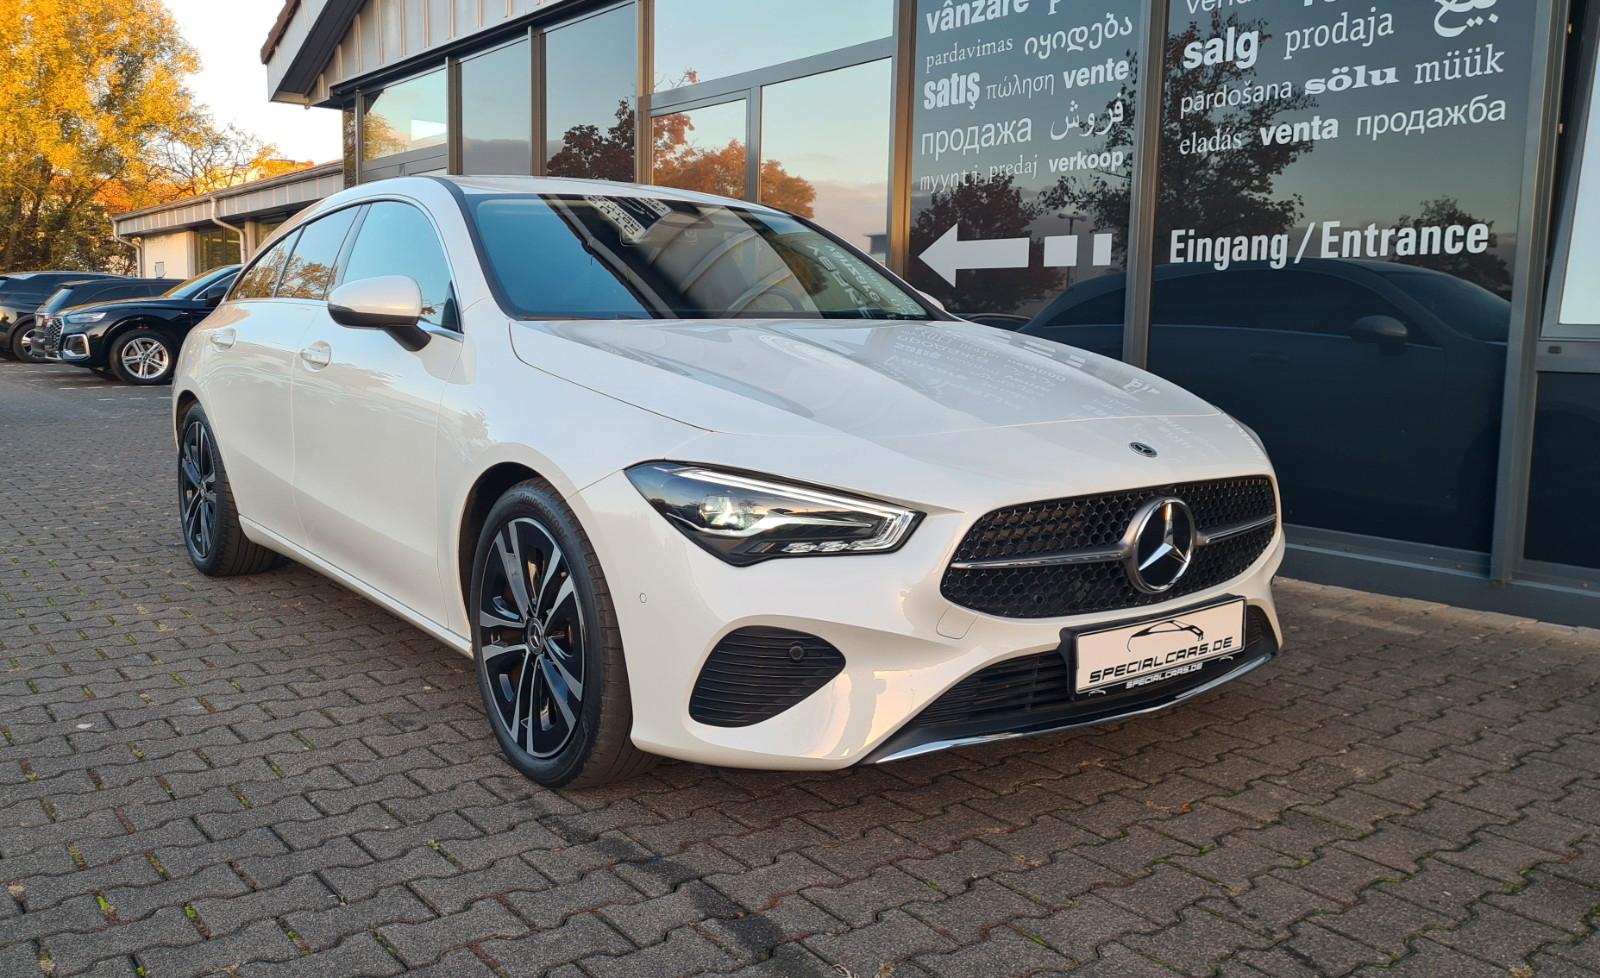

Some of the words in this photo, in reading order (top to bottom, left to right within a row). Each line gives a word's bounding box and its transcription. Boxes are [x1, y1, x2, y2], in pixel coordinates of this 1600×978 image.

[926, 37, 1014, 74] pardavimas
[1024, 12, 1133, 60] იყიდება
[1182, 26, 1259, 70] salg
[1284, 9, 1394, 60] prodaja
[923, 71, 981, 110] satış
[986, 72, 1055, 100] πώληση
[1063, 57, 1129, 89] vente
[1180, 80, 1292, 119] pārdošana
[1304, 64, 1400, 96] sölu
[1414, 43, 1505, 85] müük
[1050, 91, 1125, 141] فروش
[1179, 127, 1243, 156] eladás
[1260, 114, 1340, 147] venta
[1356, 94, 1507, 141] продажба
[921, 116, 1032, 161] продажа
[920, 163, 980, 194] myynti
[987, 154, 1038, 185] predaj
[1048, 150, 1124, 174] verkoop
[1089, 636, 1233, 683] SPECIALCARS.DE
